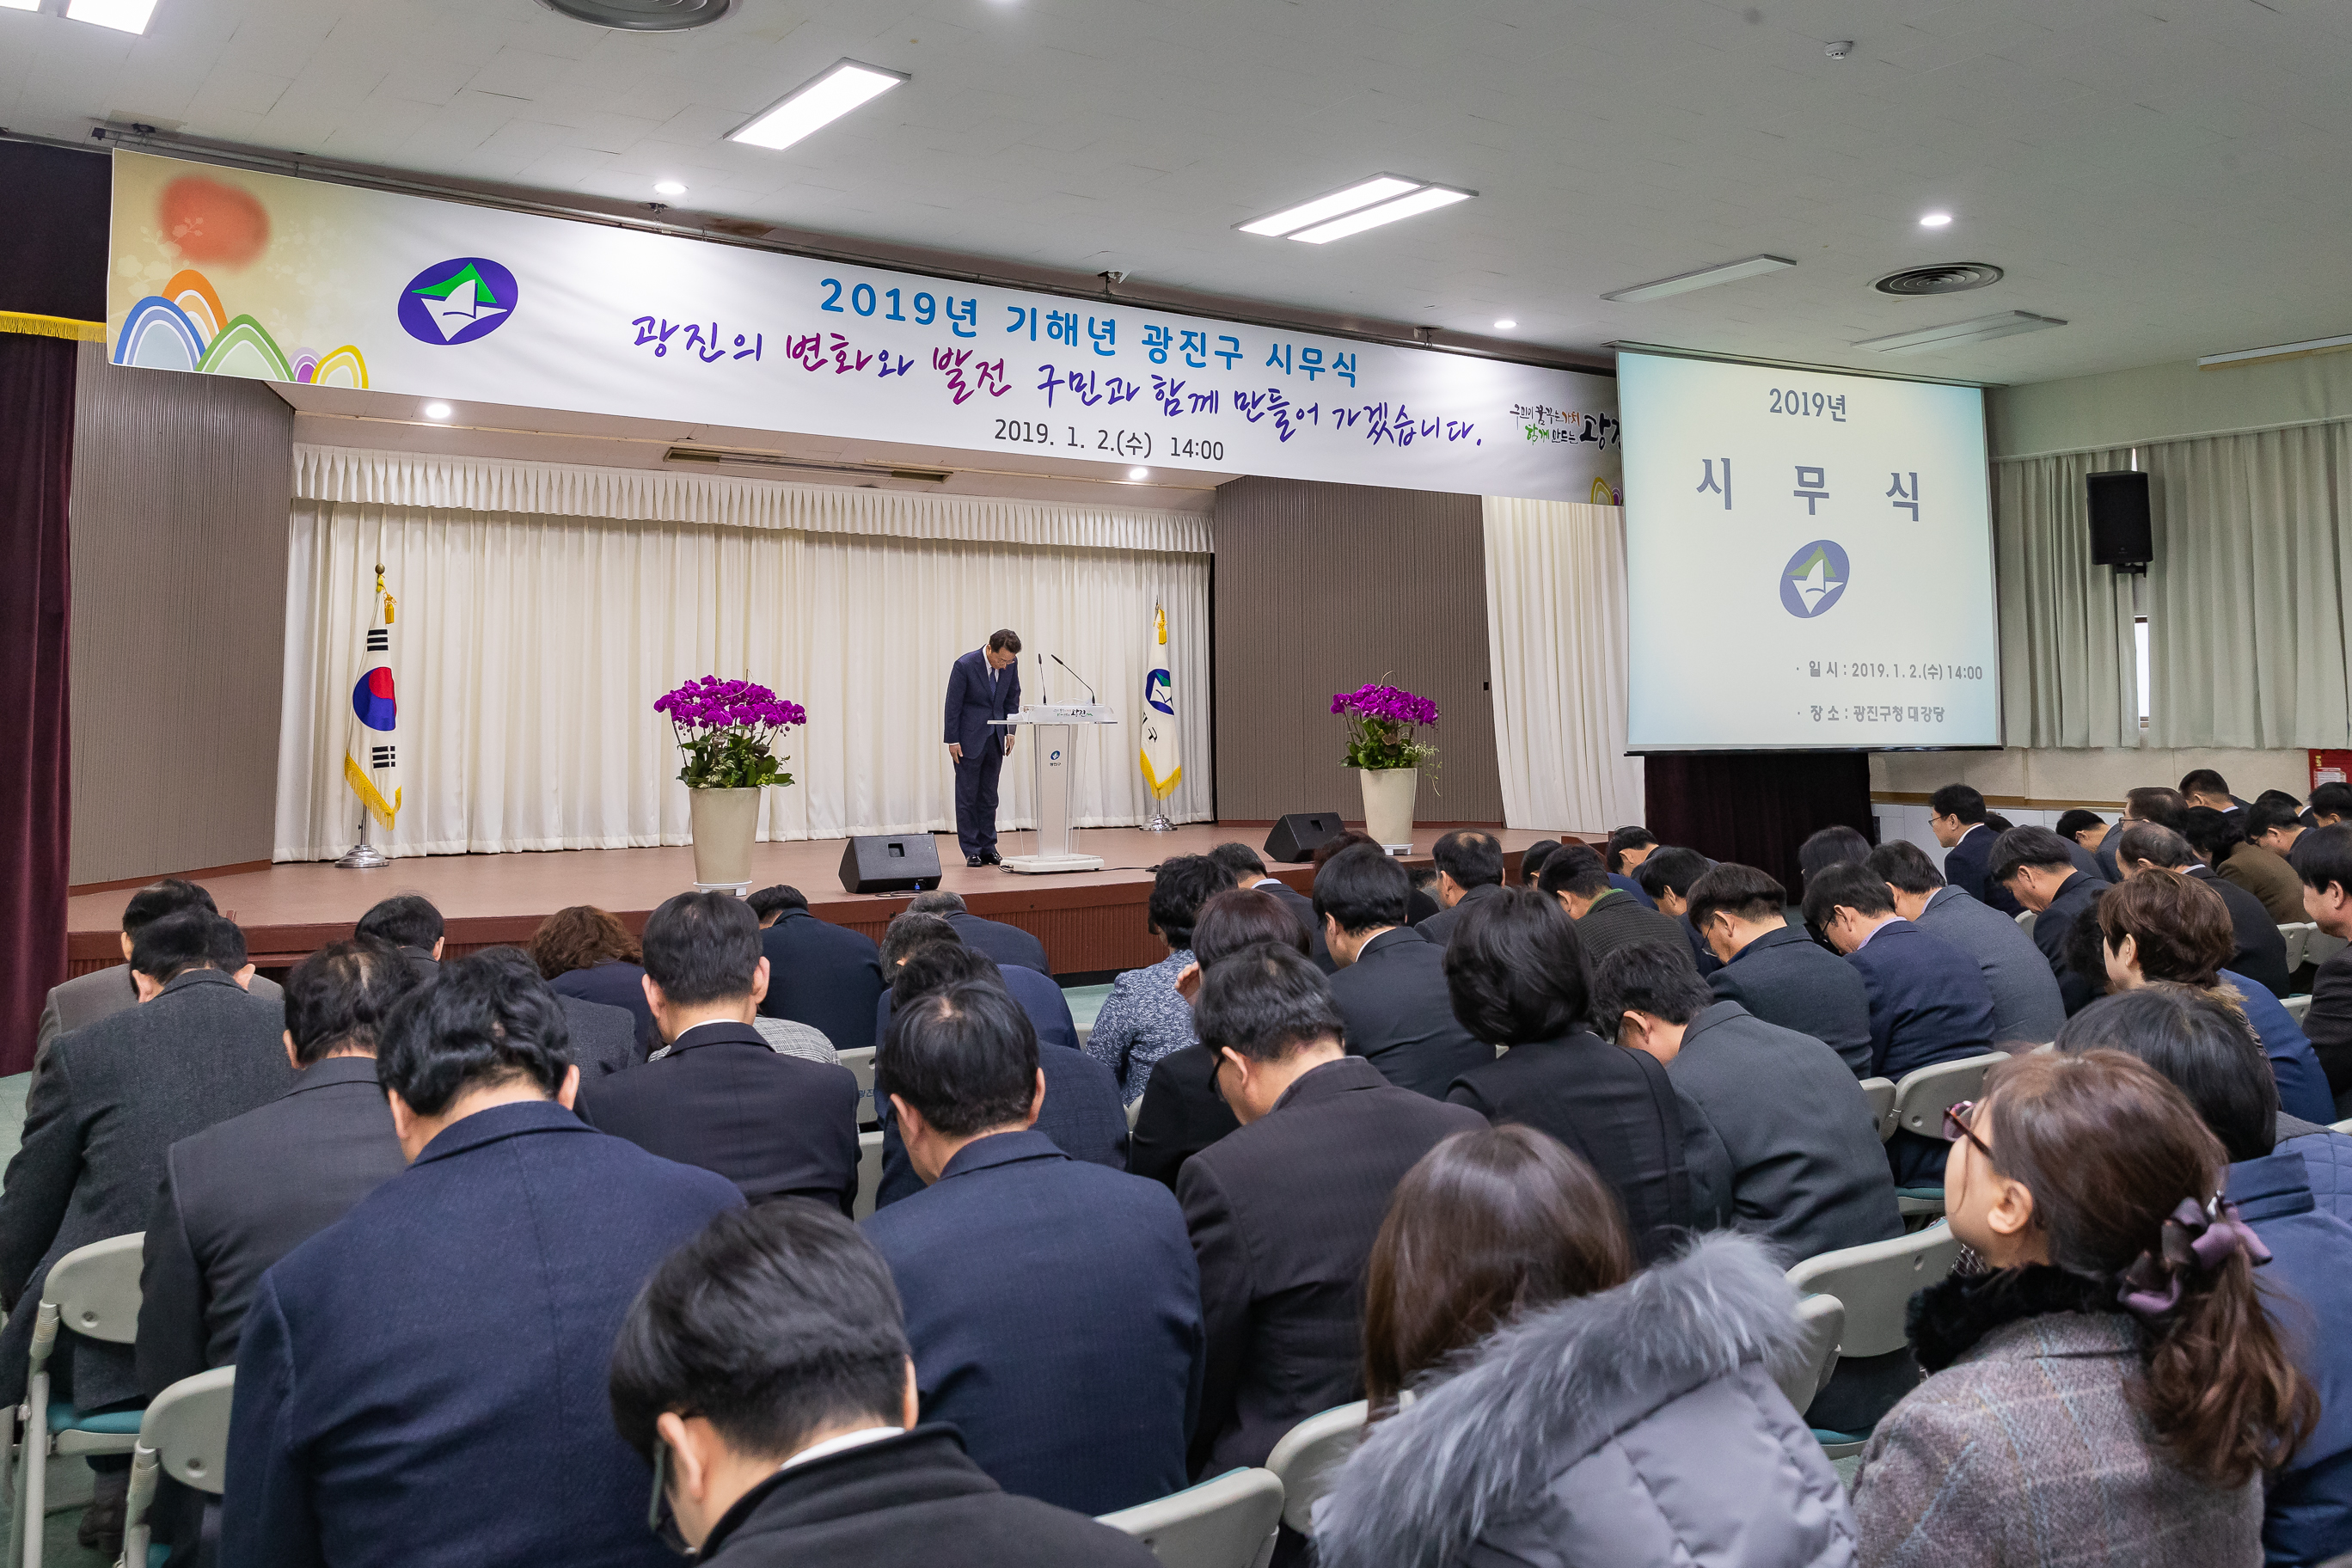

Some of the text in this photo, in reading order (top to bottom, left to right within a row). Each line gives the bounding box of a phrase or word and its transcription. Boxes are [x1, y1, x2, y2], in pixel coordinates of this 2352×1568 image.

[820, 277, 1358, 389] 2019년 기해년 광진구 시무식
[632, 315, 1482, 448] 광진의 변화와 발전 구민과 함께 만들어 가겠습니다.
[1768, 387, 1847, 424] 2019년
[994, 419, 1054, 446] 2019.
[1170, 437, 1224, 461] 14:00
[1524, 423, 1550, 445] 함께
[1947, 665, 1983, 680] 14:00
[1853, 705, 1903, 723] 광진구청
[1907, 706, 1945, 724] 대강당
